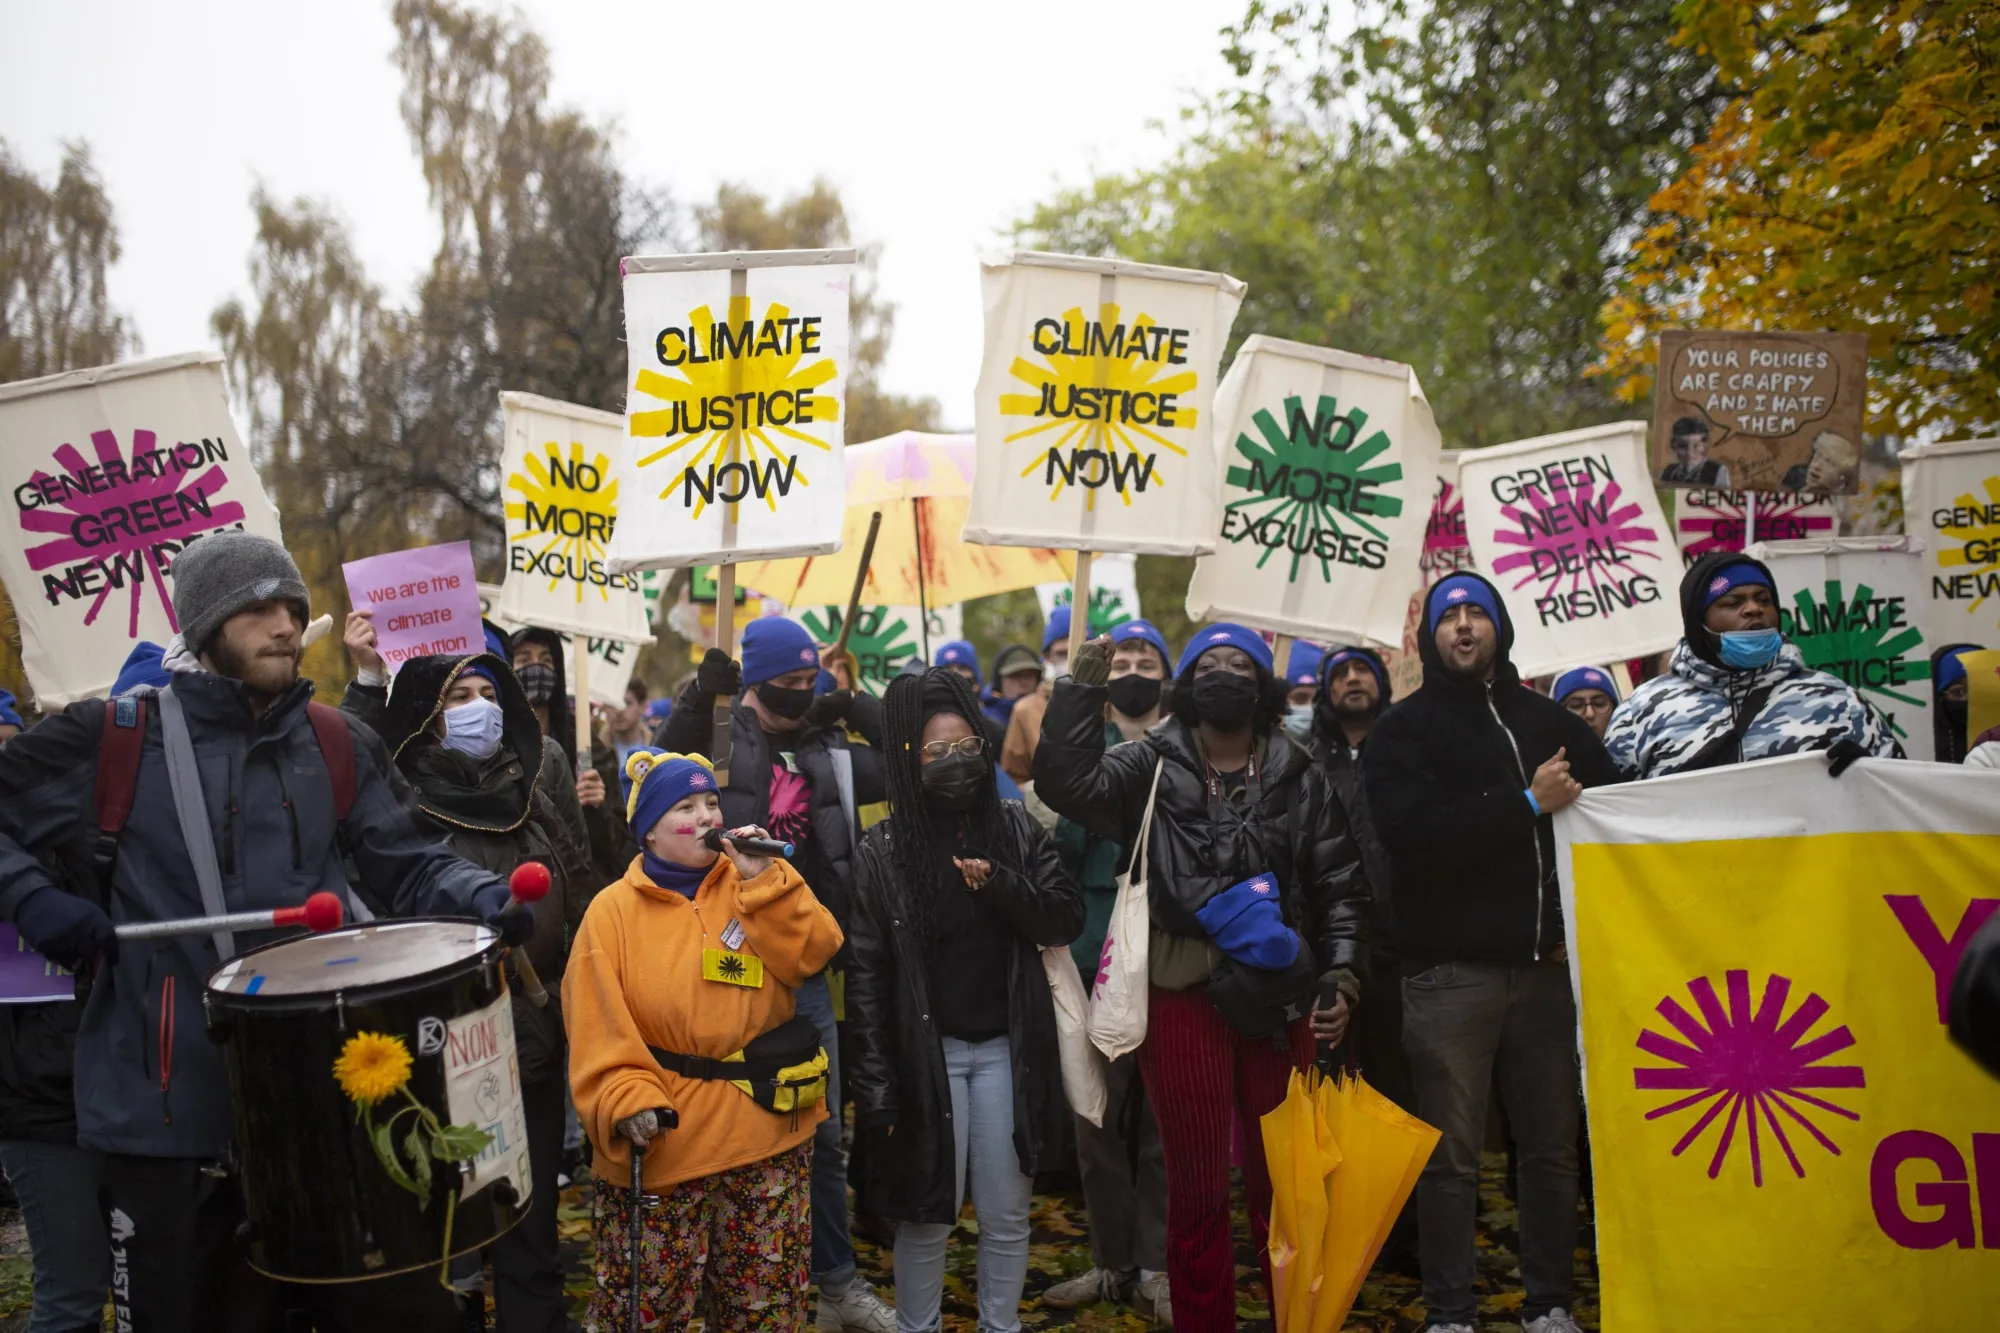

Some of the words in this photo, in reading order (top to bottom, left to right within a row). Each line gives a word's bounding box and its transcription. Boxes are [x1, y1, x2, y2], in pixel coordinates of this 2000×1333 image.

[656, 316, 822, 366] CLIMATE
[1033, 317, 1189, 365] CLIMATE
[1687, 348, 1740, 368] YOUR
[1750, 349, 1829, 369] POLICIES
[1034, 381, 1178, 427] JUSTICE
[1680, 372, 1721, 392] ARE
[1728, 373, 1815, 393] CRAPPY
[1707, 394, 1749, 413] AND
[1754, 394, 1767, 412] I
[1772, 396, 1826, 414] HATE
[666, 388, 815, 437] JUSTICE
[1289, 407, 1358, 451] NO
[1737, 415, 1797, 433] THEM
[14, 437, 230, 512] GENERATION
[549, 457, 600, 493] NO
[684, 455, 798, 508] NOW
[1046, 447, 1156, 493] NOW
[1246, 458, 1380, 516] MORE
[1491, 454, 1616, 505] GREEN
[70, 487, 214, 549] GREEN
[1221, 508, 1389, 570] EXCUSES
[1519, 494, 1609, 542] NEW
[42, 549, 144, 607] NEW
[511, 546, 639, 592] EXCUSES
[1530, 536, 1632, 583] DEAL
[367, 586, 397, 604] we
[400, 581, 429, 598] are
[431, 575, 461, 592] the
[1535, 575, 1662, 627] RISING
[387, 608, 452, 632] climate
[1779, 597, 1907, 638] CLIMATE
[385, 635, 468, 662] revolution
[111, 1245, 130, 1302] JUST
